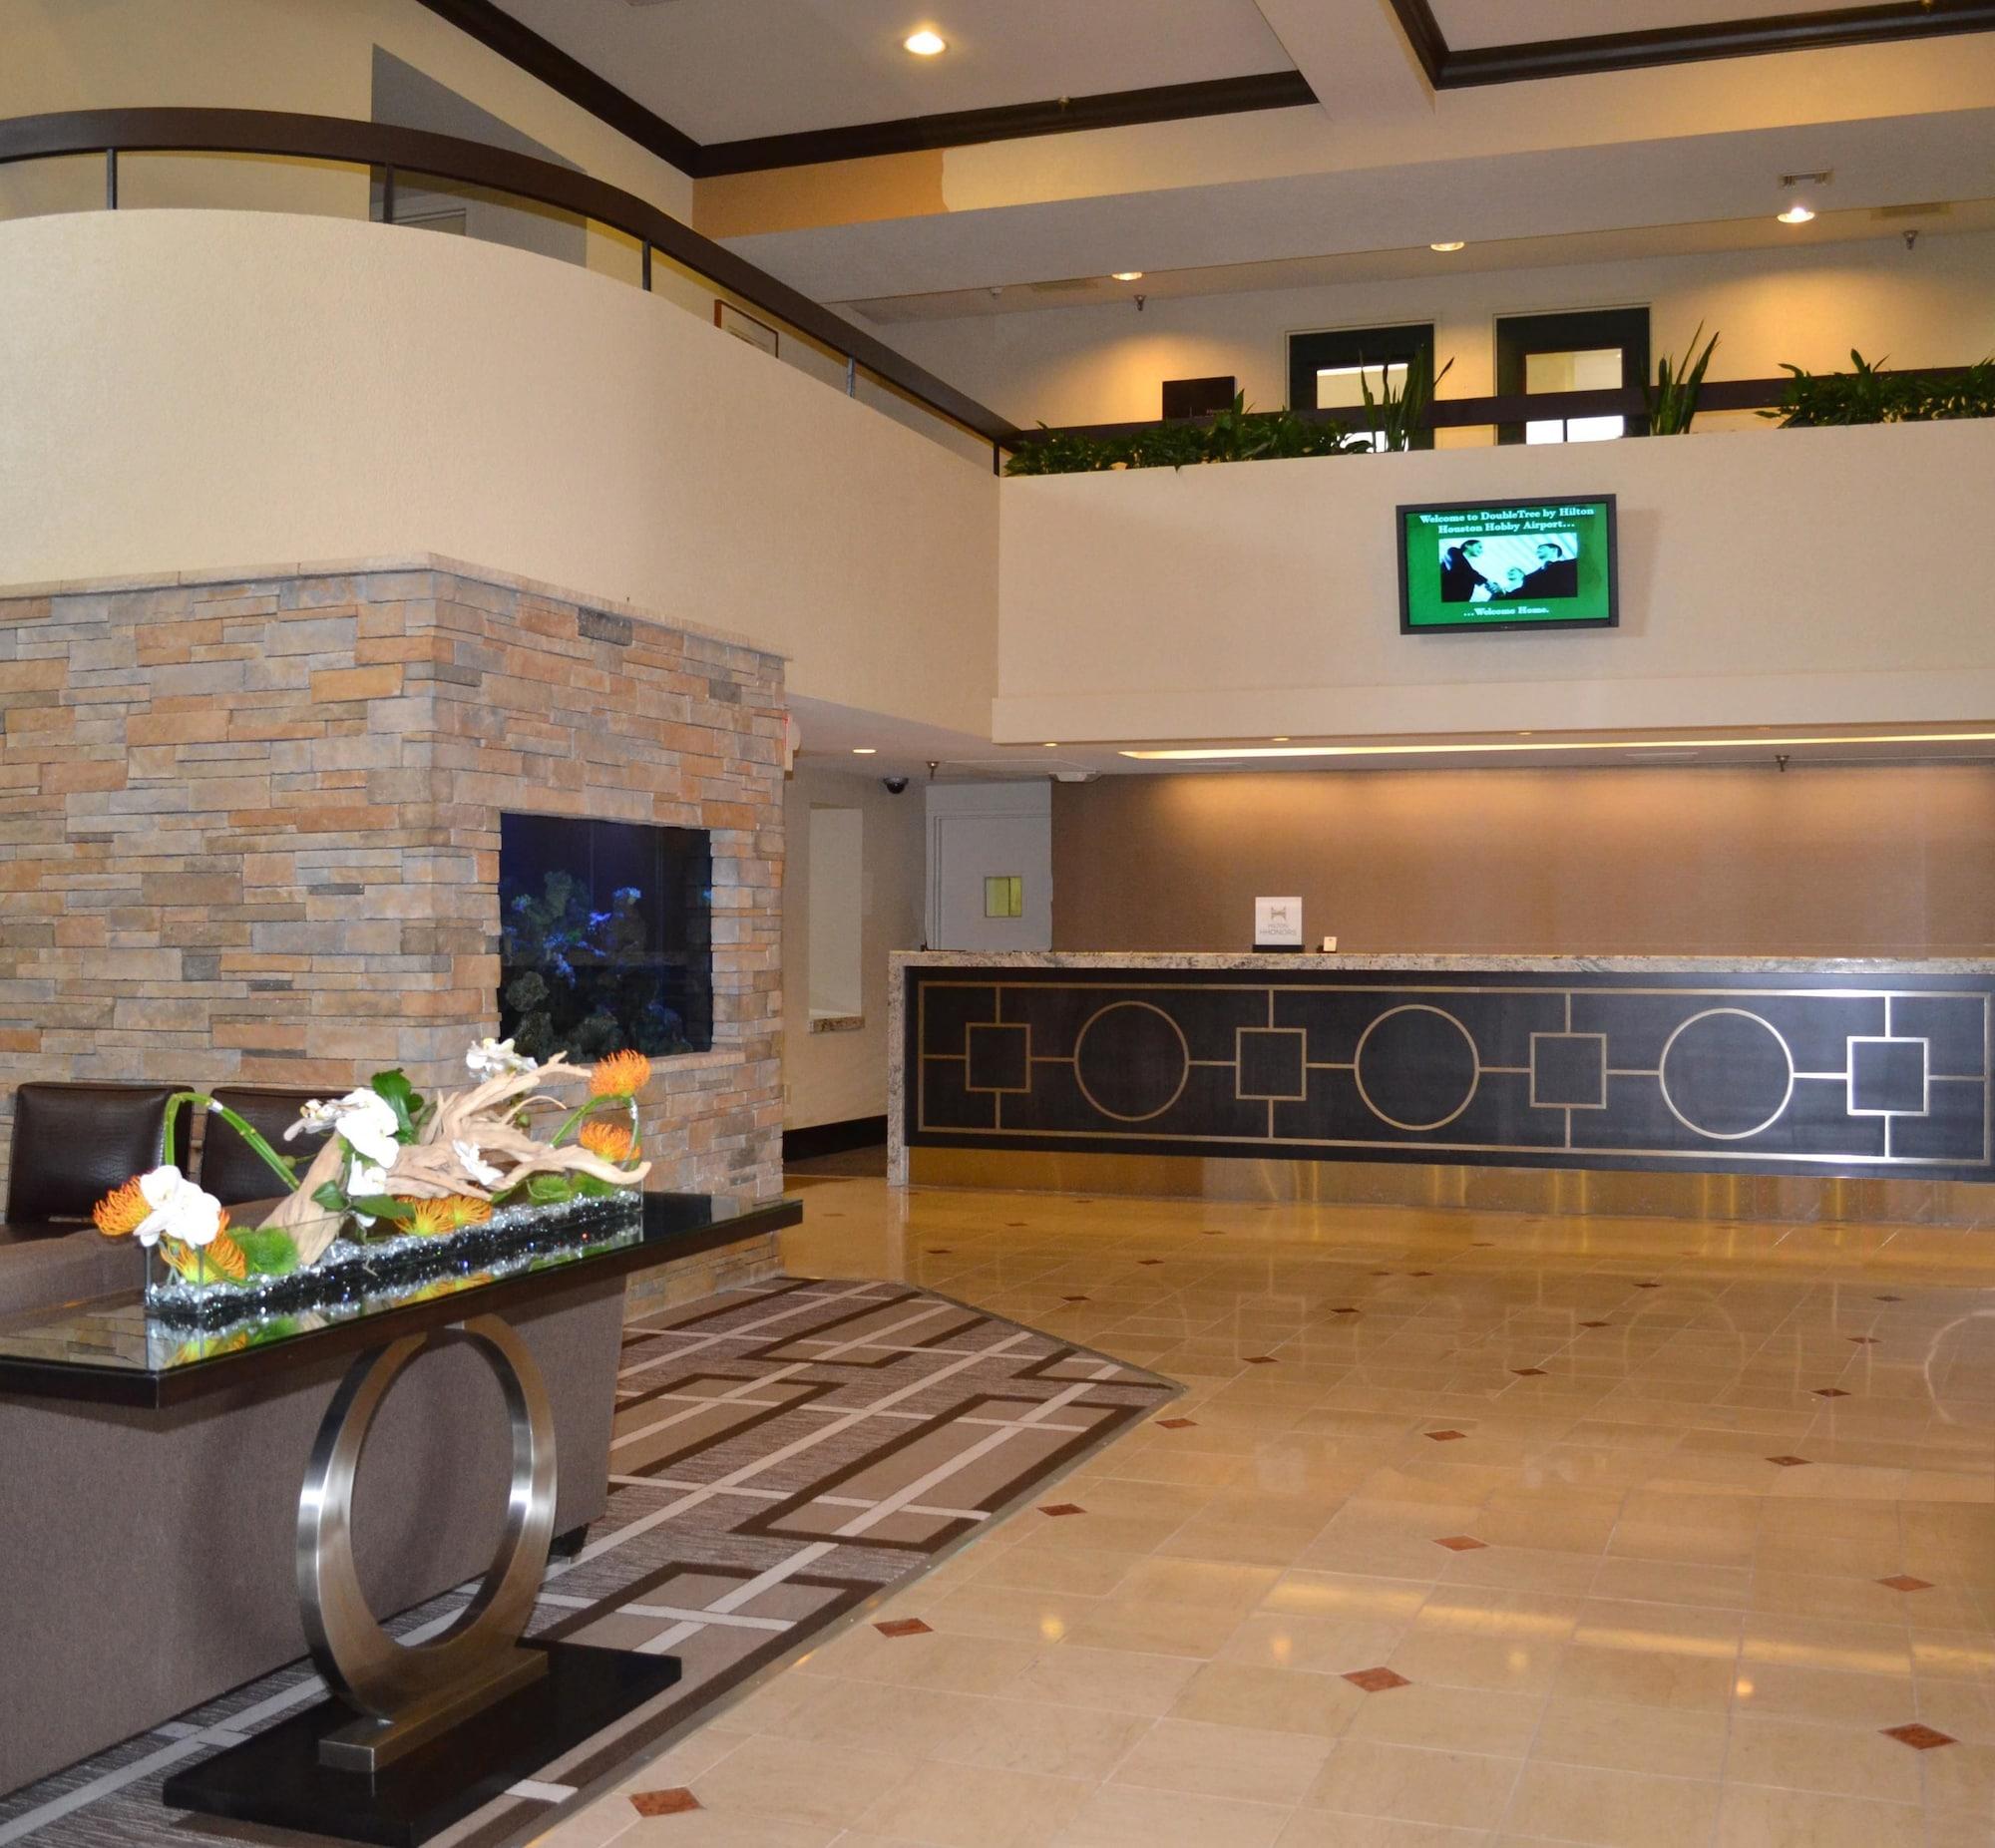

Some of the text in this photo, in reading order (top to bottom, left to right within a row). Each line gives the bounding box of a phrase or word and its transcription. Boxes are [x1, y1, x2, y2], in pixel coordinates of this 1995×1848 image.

[1419, 514, 1465, 525] Welcome
[1480, 510, 1541, 521] DoubleTree
[1542, 510, 1556, 520] by
[1559, 508, 1594, 517] Hilton
[1437, 521, 1575, 535] Houston Hobby Airport...
